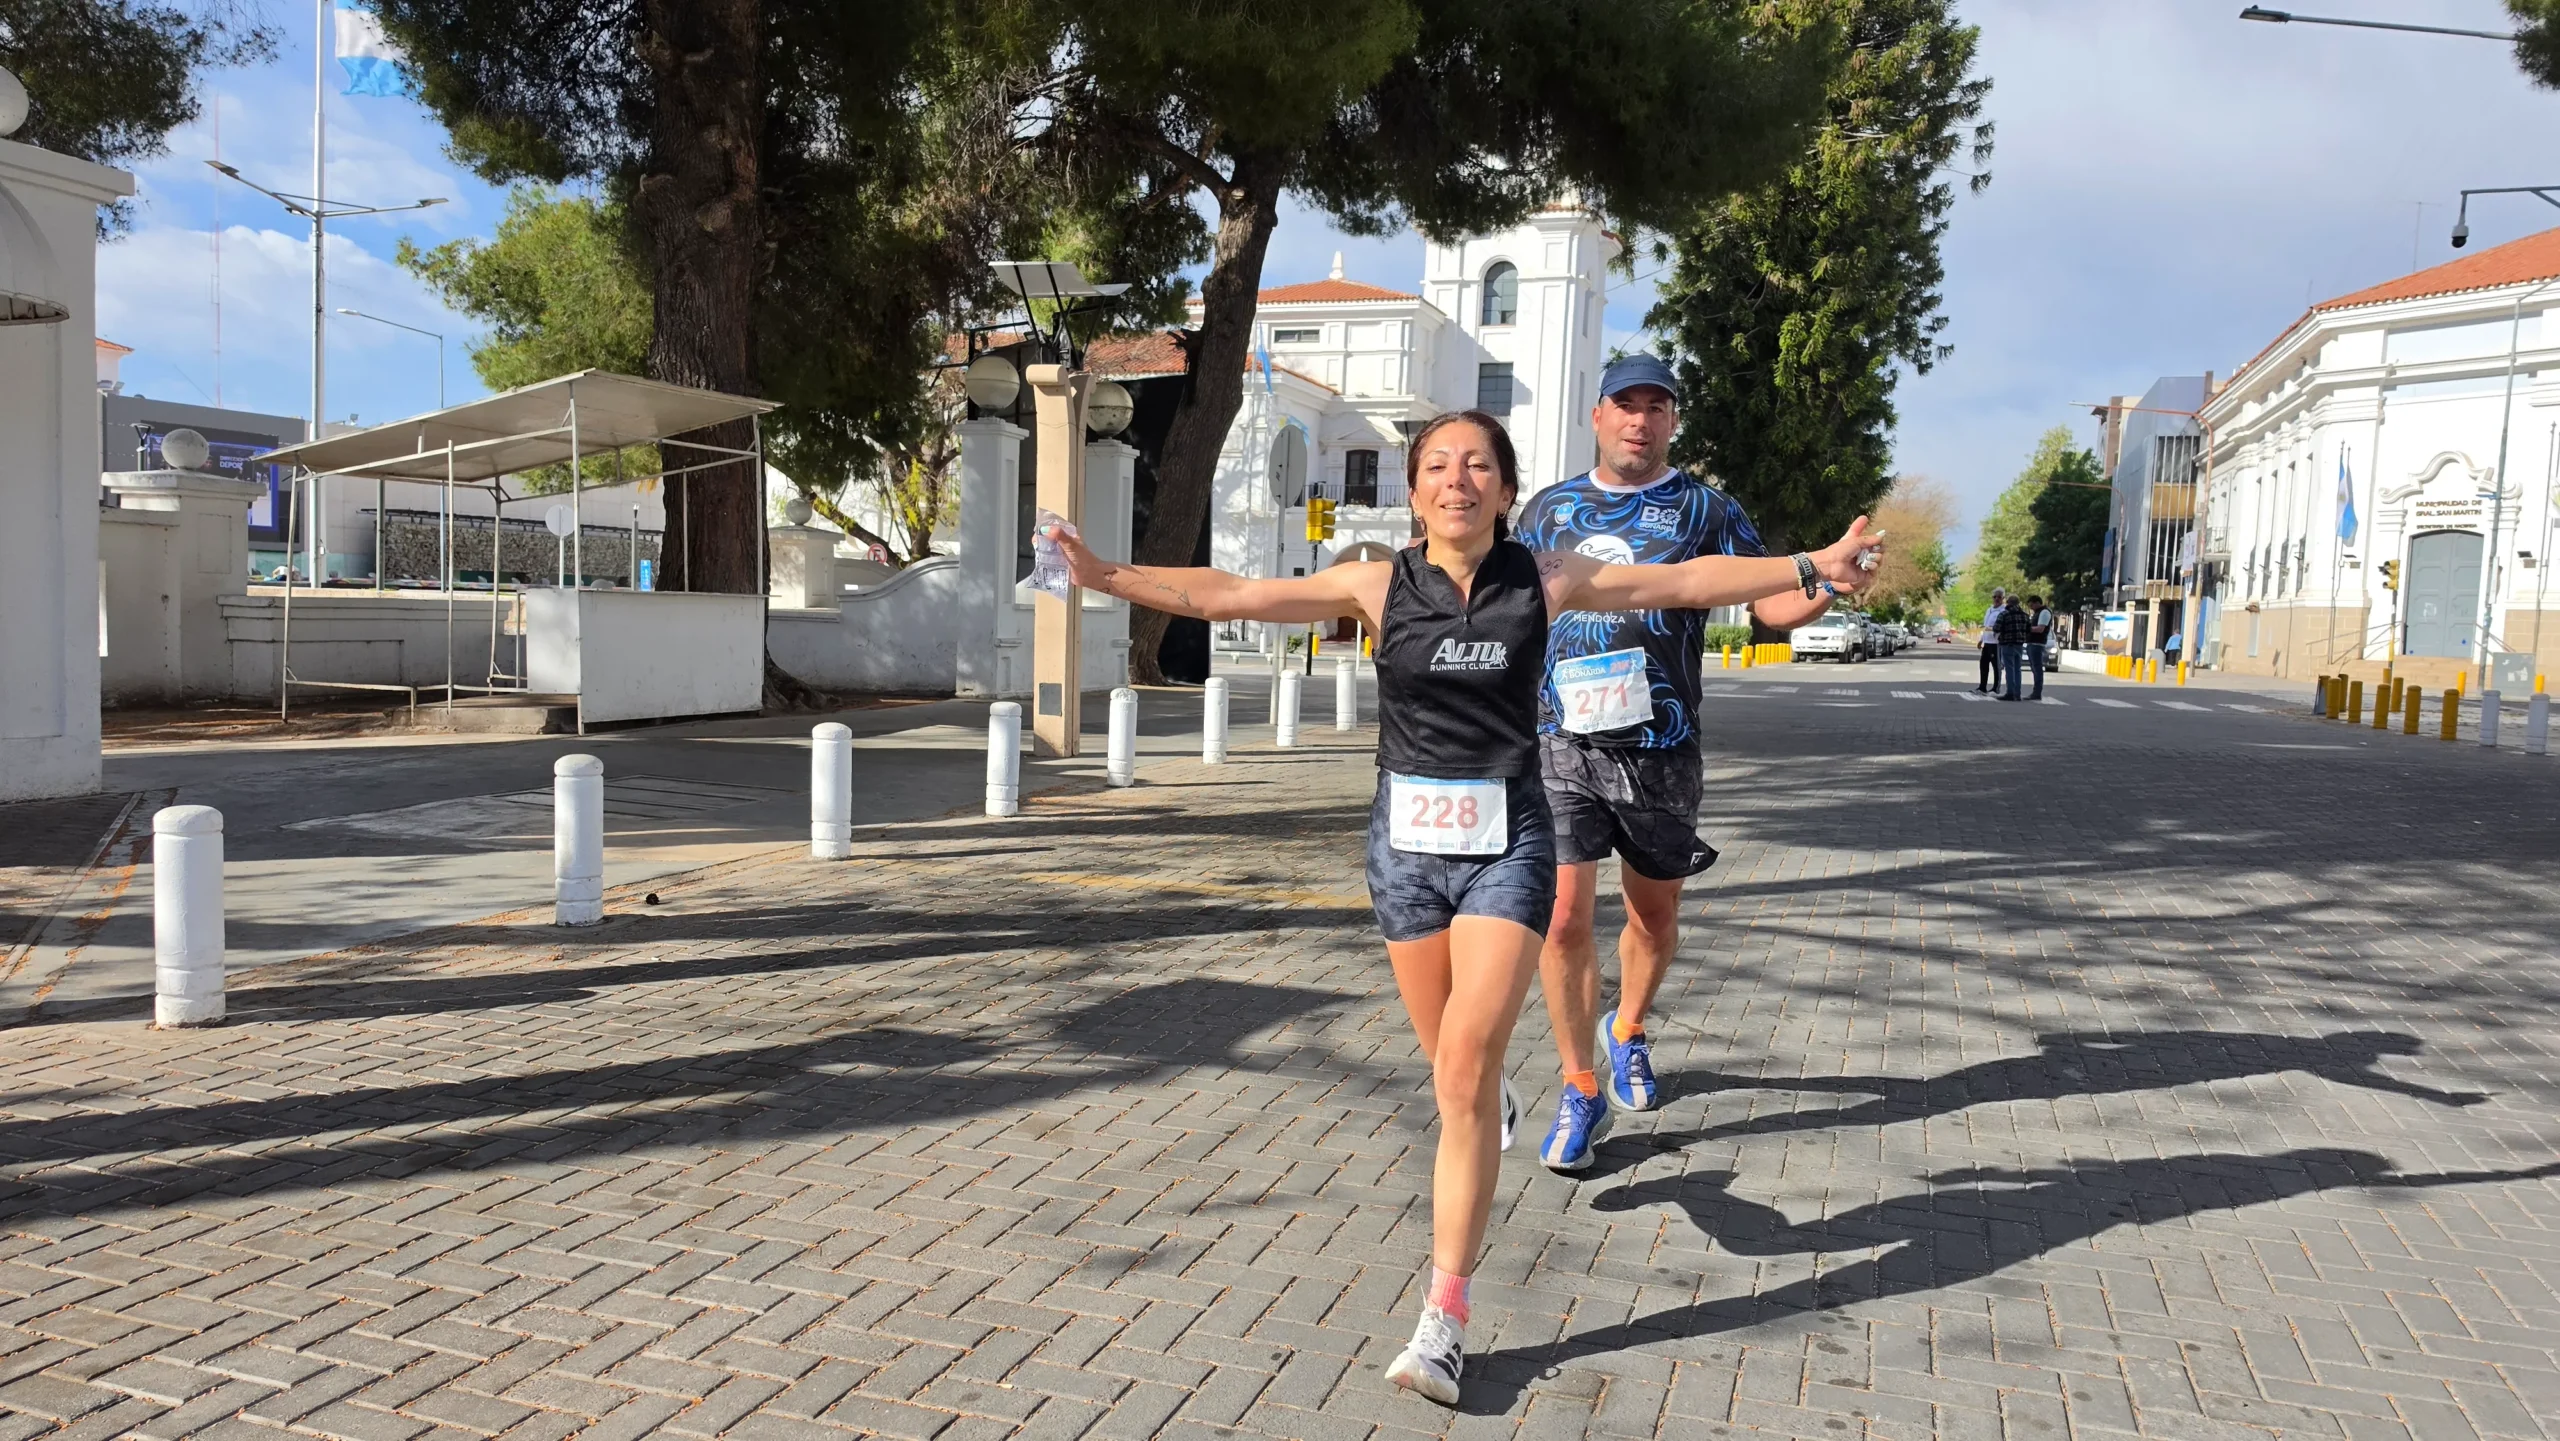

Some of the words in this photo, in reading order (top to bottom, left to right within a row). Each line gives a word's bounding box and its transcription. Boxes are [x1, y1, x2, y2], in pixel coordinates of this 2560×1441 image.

[1573, 614, 1625, 624] MENDOZA
[1430, 662, 1466, 671] RUNNING
[1469, 662, 1489, 670] CLUB
[1569, 667, 1607, 679] BONARDA
[1575, 683, 1628, 715] 271
[1411, 794, 1479, 829] 228
